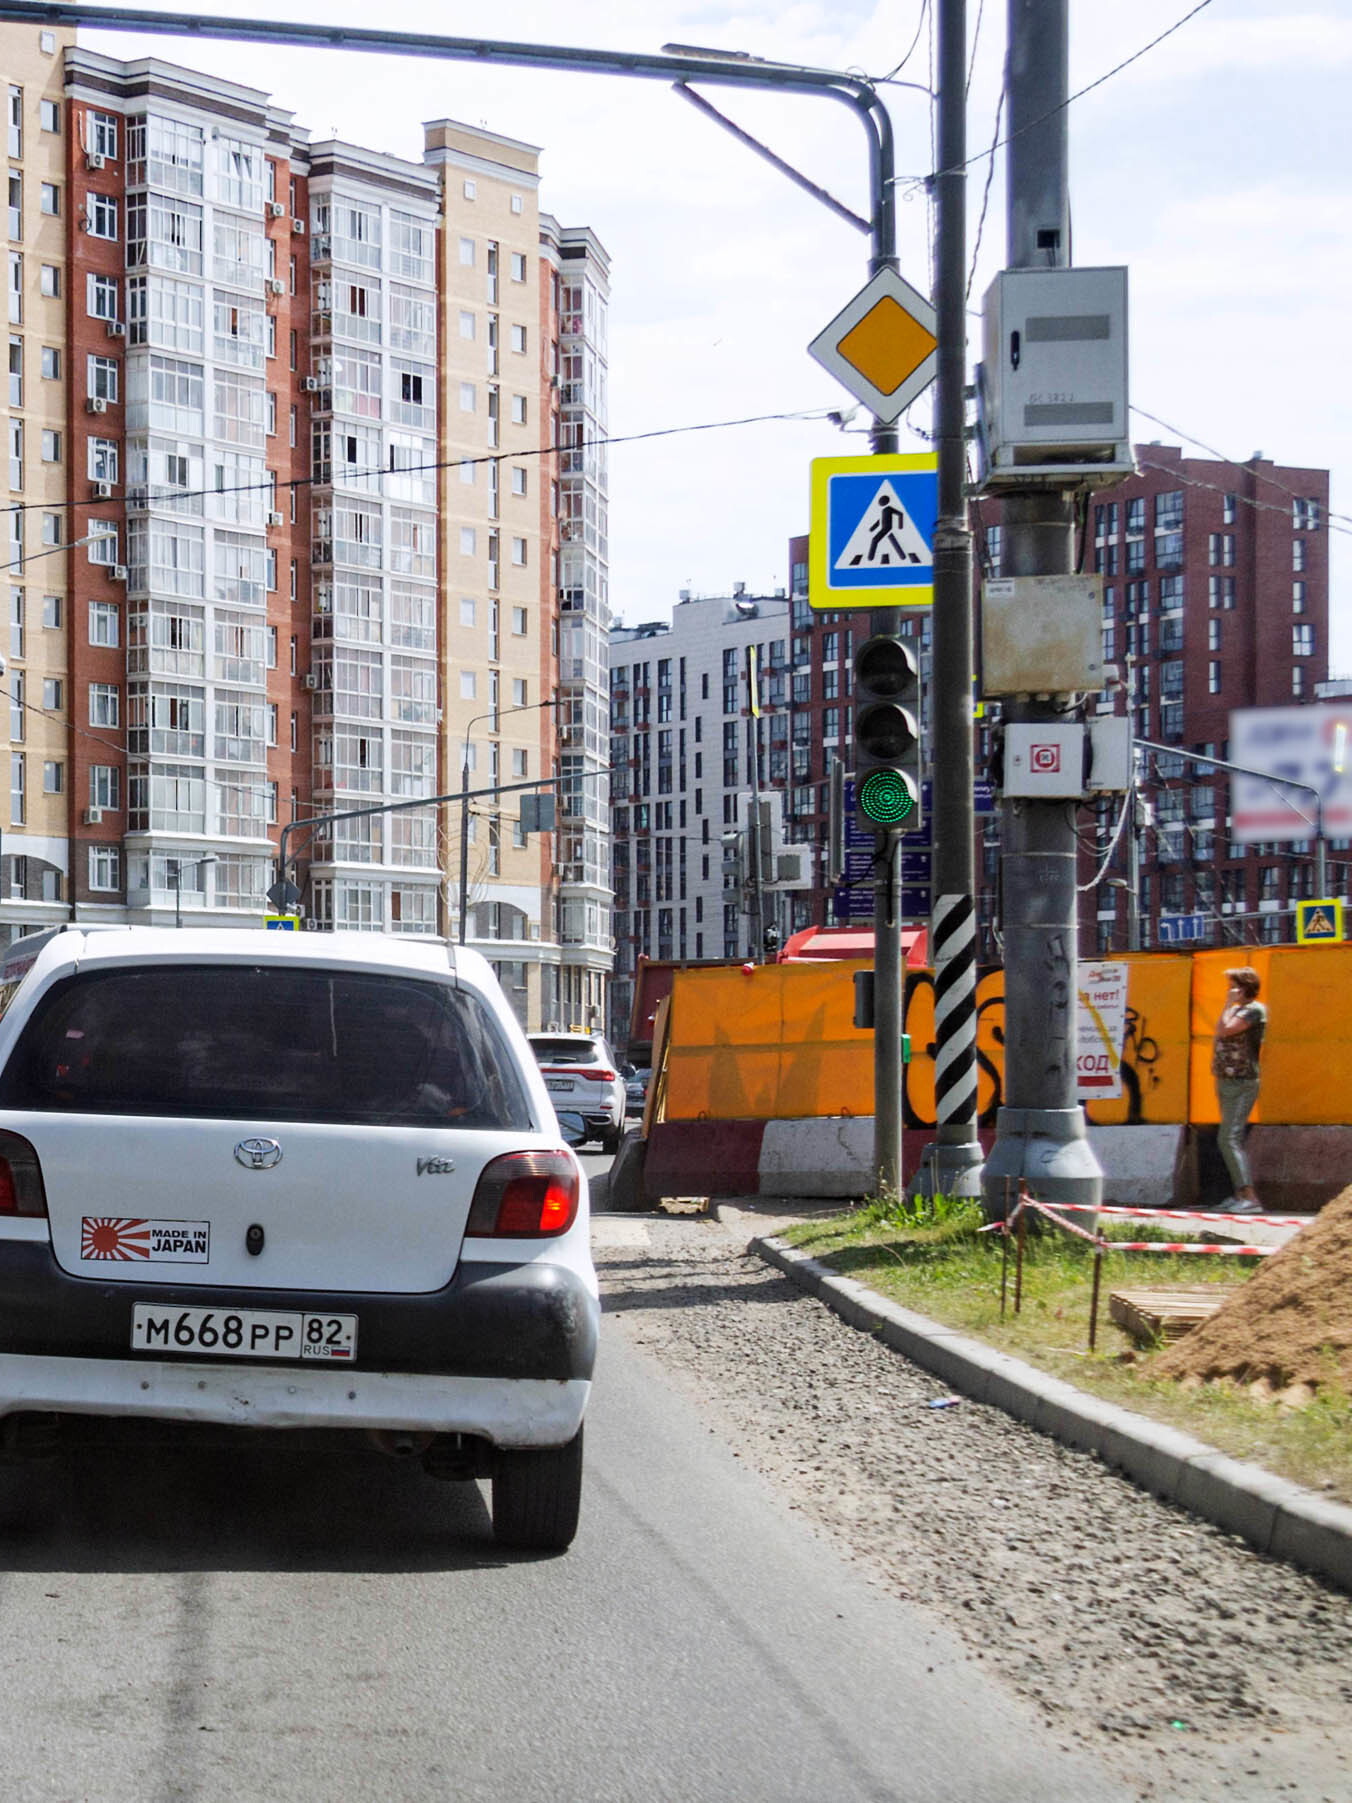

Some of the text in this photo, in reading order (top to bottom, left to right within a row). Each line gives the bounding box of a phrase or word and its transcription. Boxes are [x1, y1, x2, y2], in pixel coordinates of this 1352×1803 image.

[151, 1229, 207, 1239] MADE IN
[152, 1239, 206, 1253] JAPAN
[146, 1312, 343, 1351] М668РР 82
[303, 1344, 330, 1356] RUS
